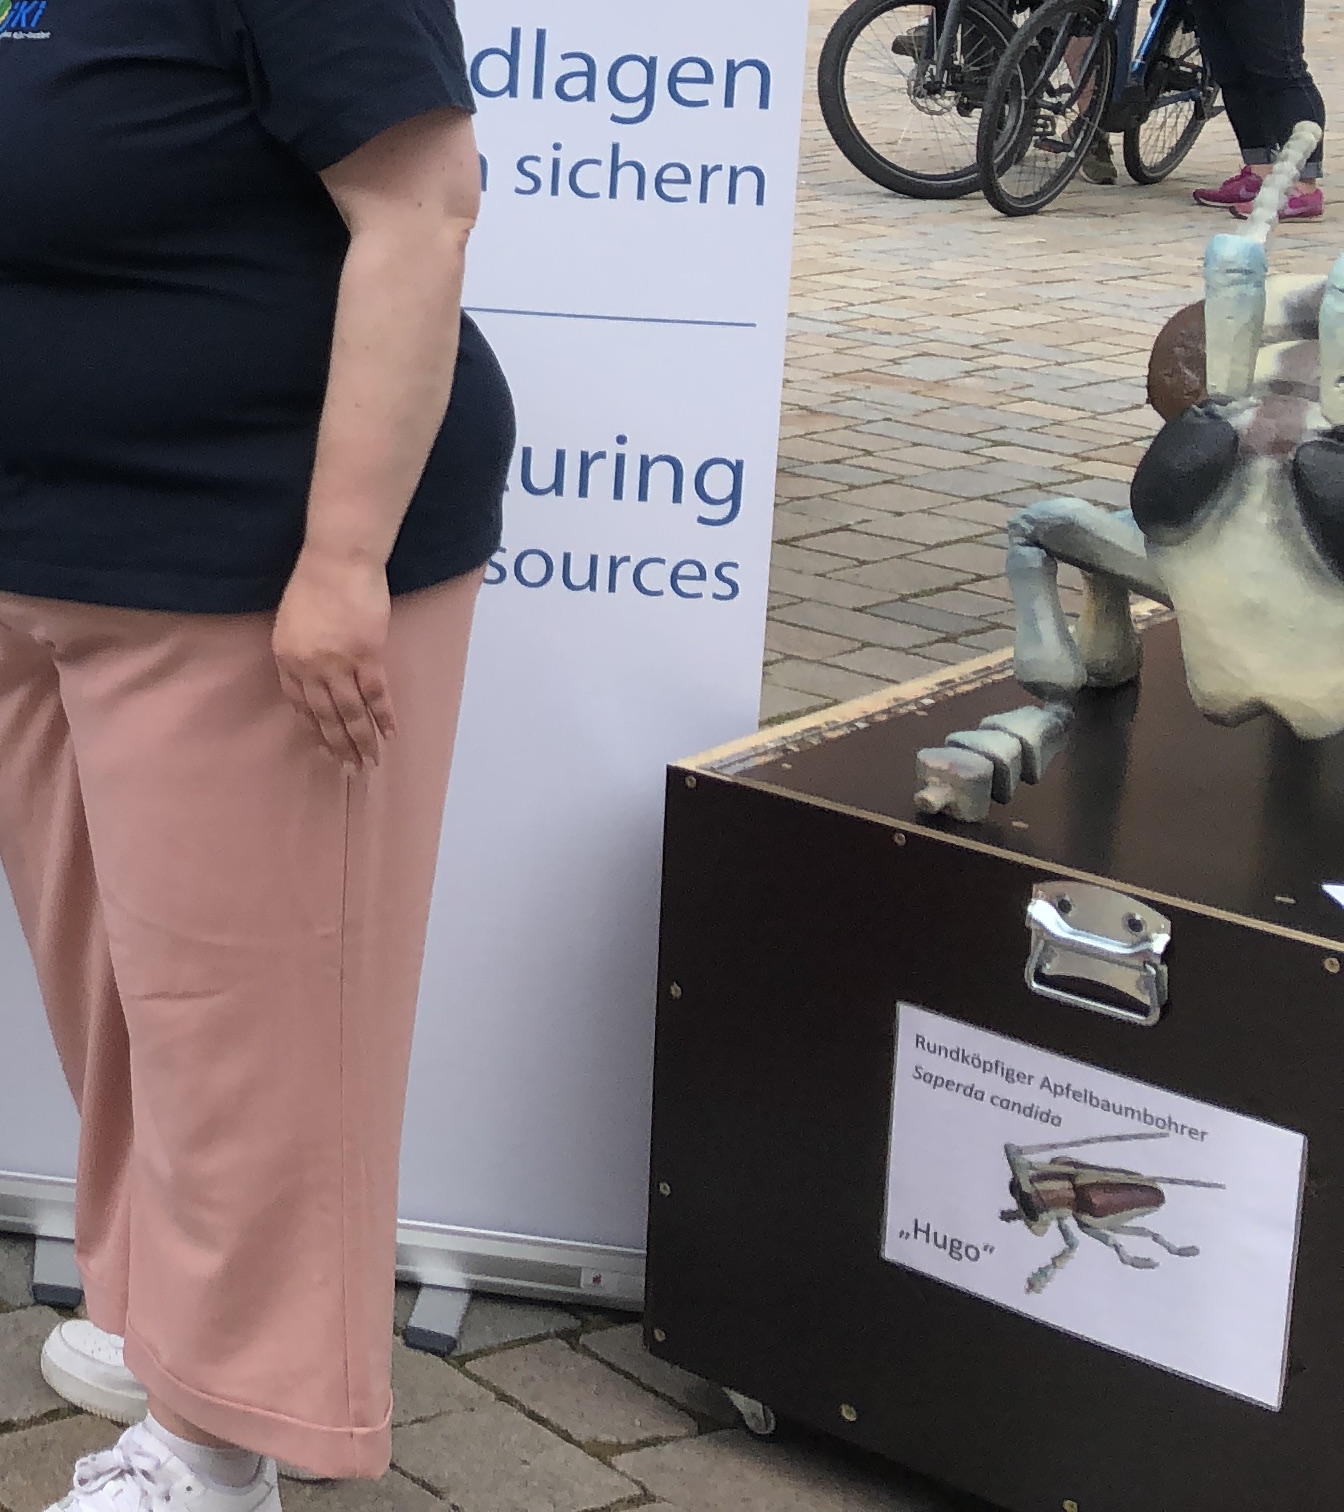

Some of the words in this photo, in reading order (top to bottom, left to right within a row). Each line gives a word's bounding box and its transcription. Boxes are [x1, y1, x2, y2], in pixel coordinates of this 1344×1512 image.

[469, 26, 771, 125] dlagen
[514, 142, 766, 206] sichern
[521, 434, 744, 526] uring
[483, 546, 740, 601] sources
[912, 1064, 985, 1102] Saperda
[989, 1092, 1062, 1128] candida
[914, 1033, 1035, 1086] Rundköpfiger
[1039, 1075, 1209, 1143] Apfelbaumbohrer
